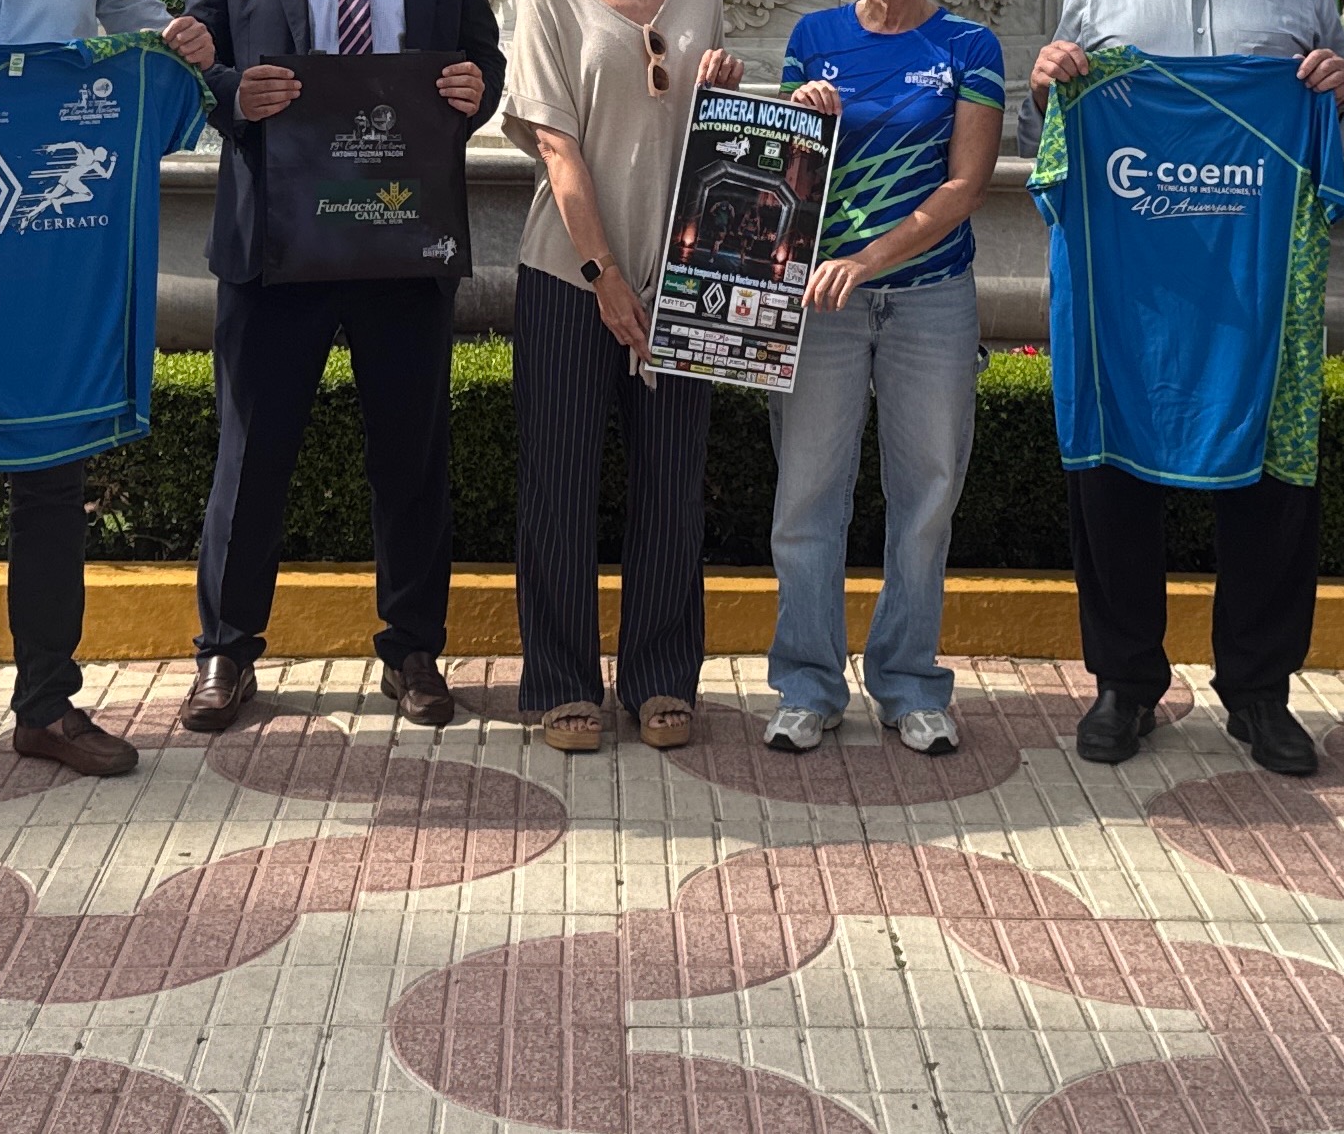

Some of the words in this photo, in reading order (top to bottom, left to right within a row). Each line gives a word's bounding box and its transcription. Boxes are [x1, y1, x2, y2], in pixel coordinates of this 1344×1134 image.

[698, 97, 755, 123] CARRERA
[757, 102, 823, 141] NOCTURNA
[691, 122, 741, 133] ANTONIO
[743, 127, 790, 142] GUZMAN
[792, 135, 829, 158] TACON
[331, 150, 358, 158] ANTONIO
[1156, 158, 1265, 186] coemi
[1189, 185, 1198, 194] DE
[316, 198, 385, 215] Fundación
[383, 210, 420, 220] RURAL
[1131, 196, 1171, 216] 40
[1171, 197, 1246, 215] Aniversario
[31, 214, 110, 232] CERRATO
